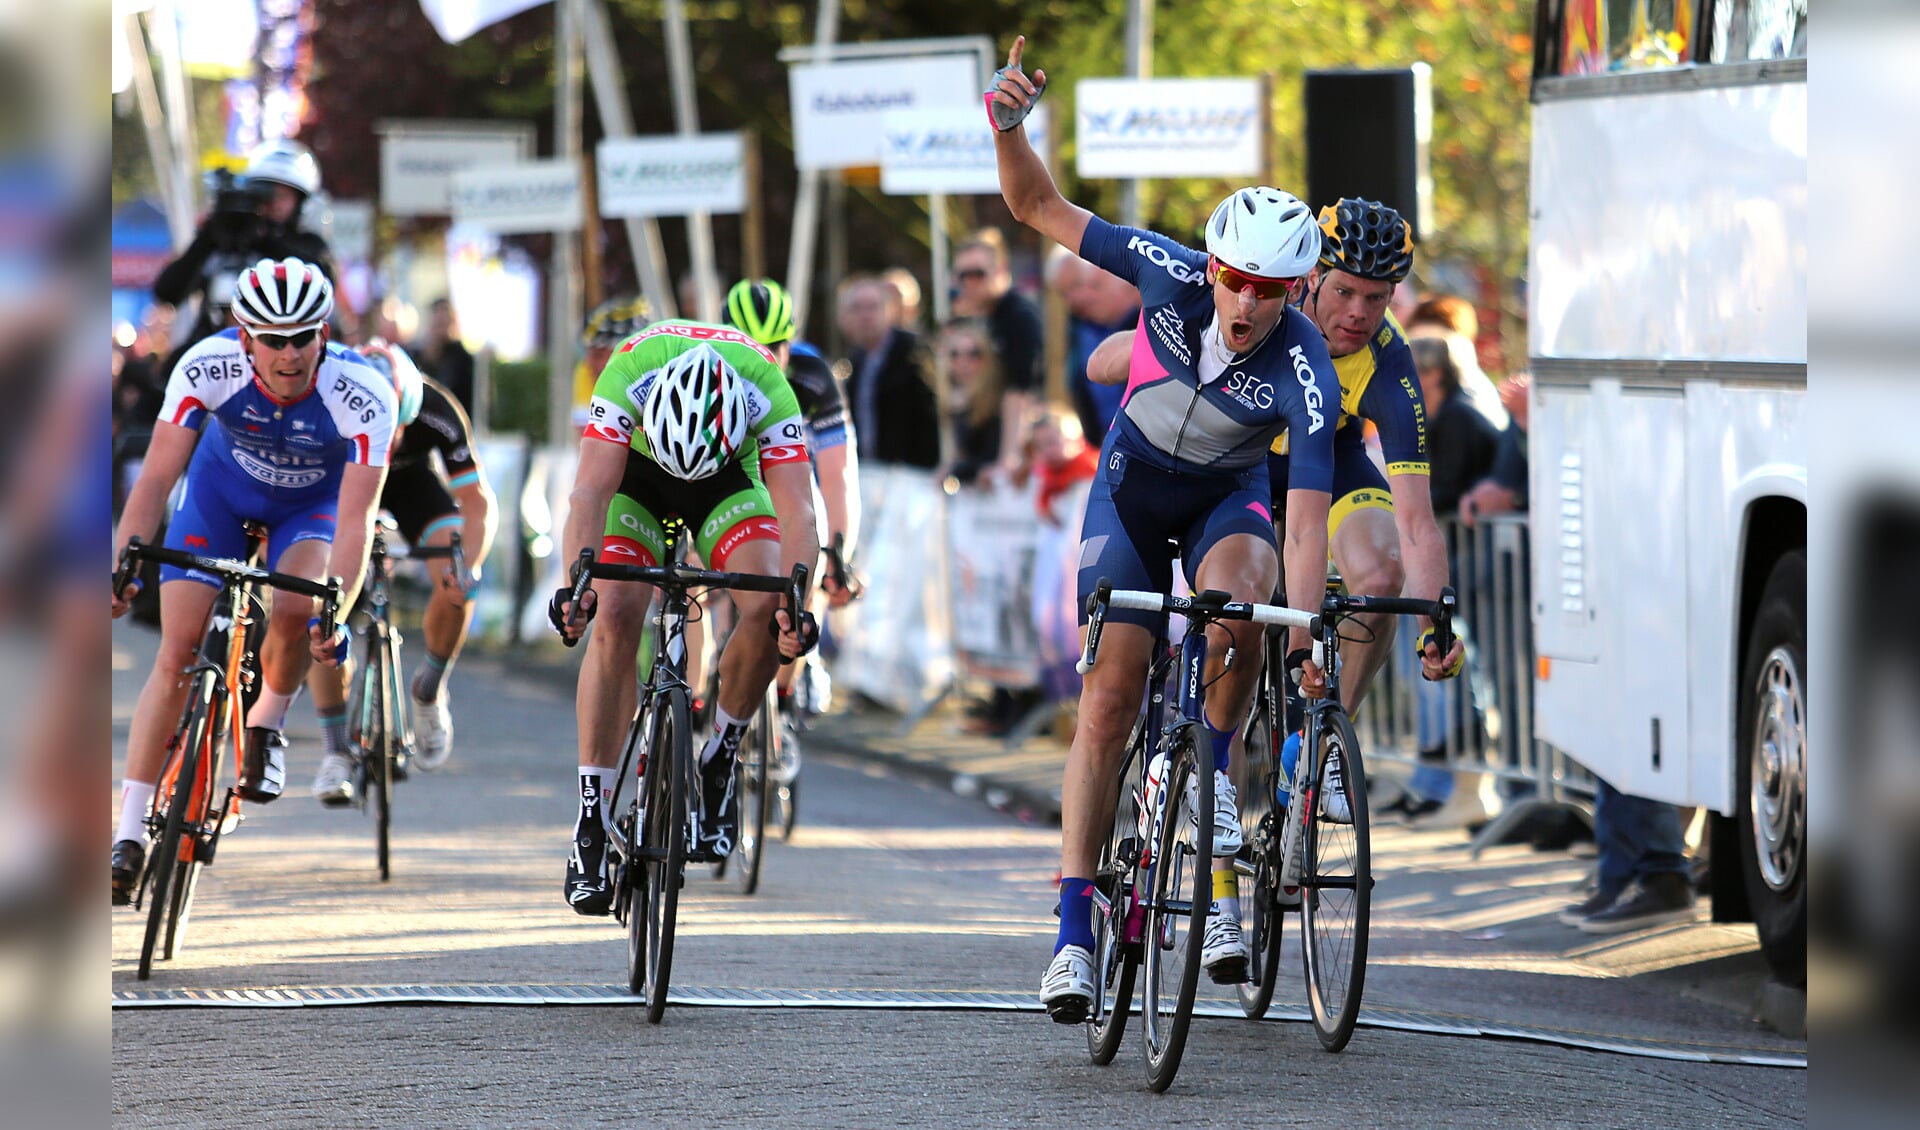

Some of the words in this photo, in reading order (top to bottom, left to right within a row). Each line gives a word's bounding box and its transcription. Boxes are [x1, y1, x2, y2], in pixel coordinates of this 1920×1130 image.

[1127, 235, 1205, 288] KOGA
[1149, 317, 1191, 367] SHIMANO
[186, 361, 243, 389] Piels
[1228, 371, 1275, 410] SEG
[1289, 344, 1325, 436] KOGA
[1400, 376, 1417, 400] DE
[333, 378, 376, 424] Piels
[619, 513, 666, 554] Qute
[704, 501, 756, 538] Qute
[1189, 656, 1199, 698] KOGA
